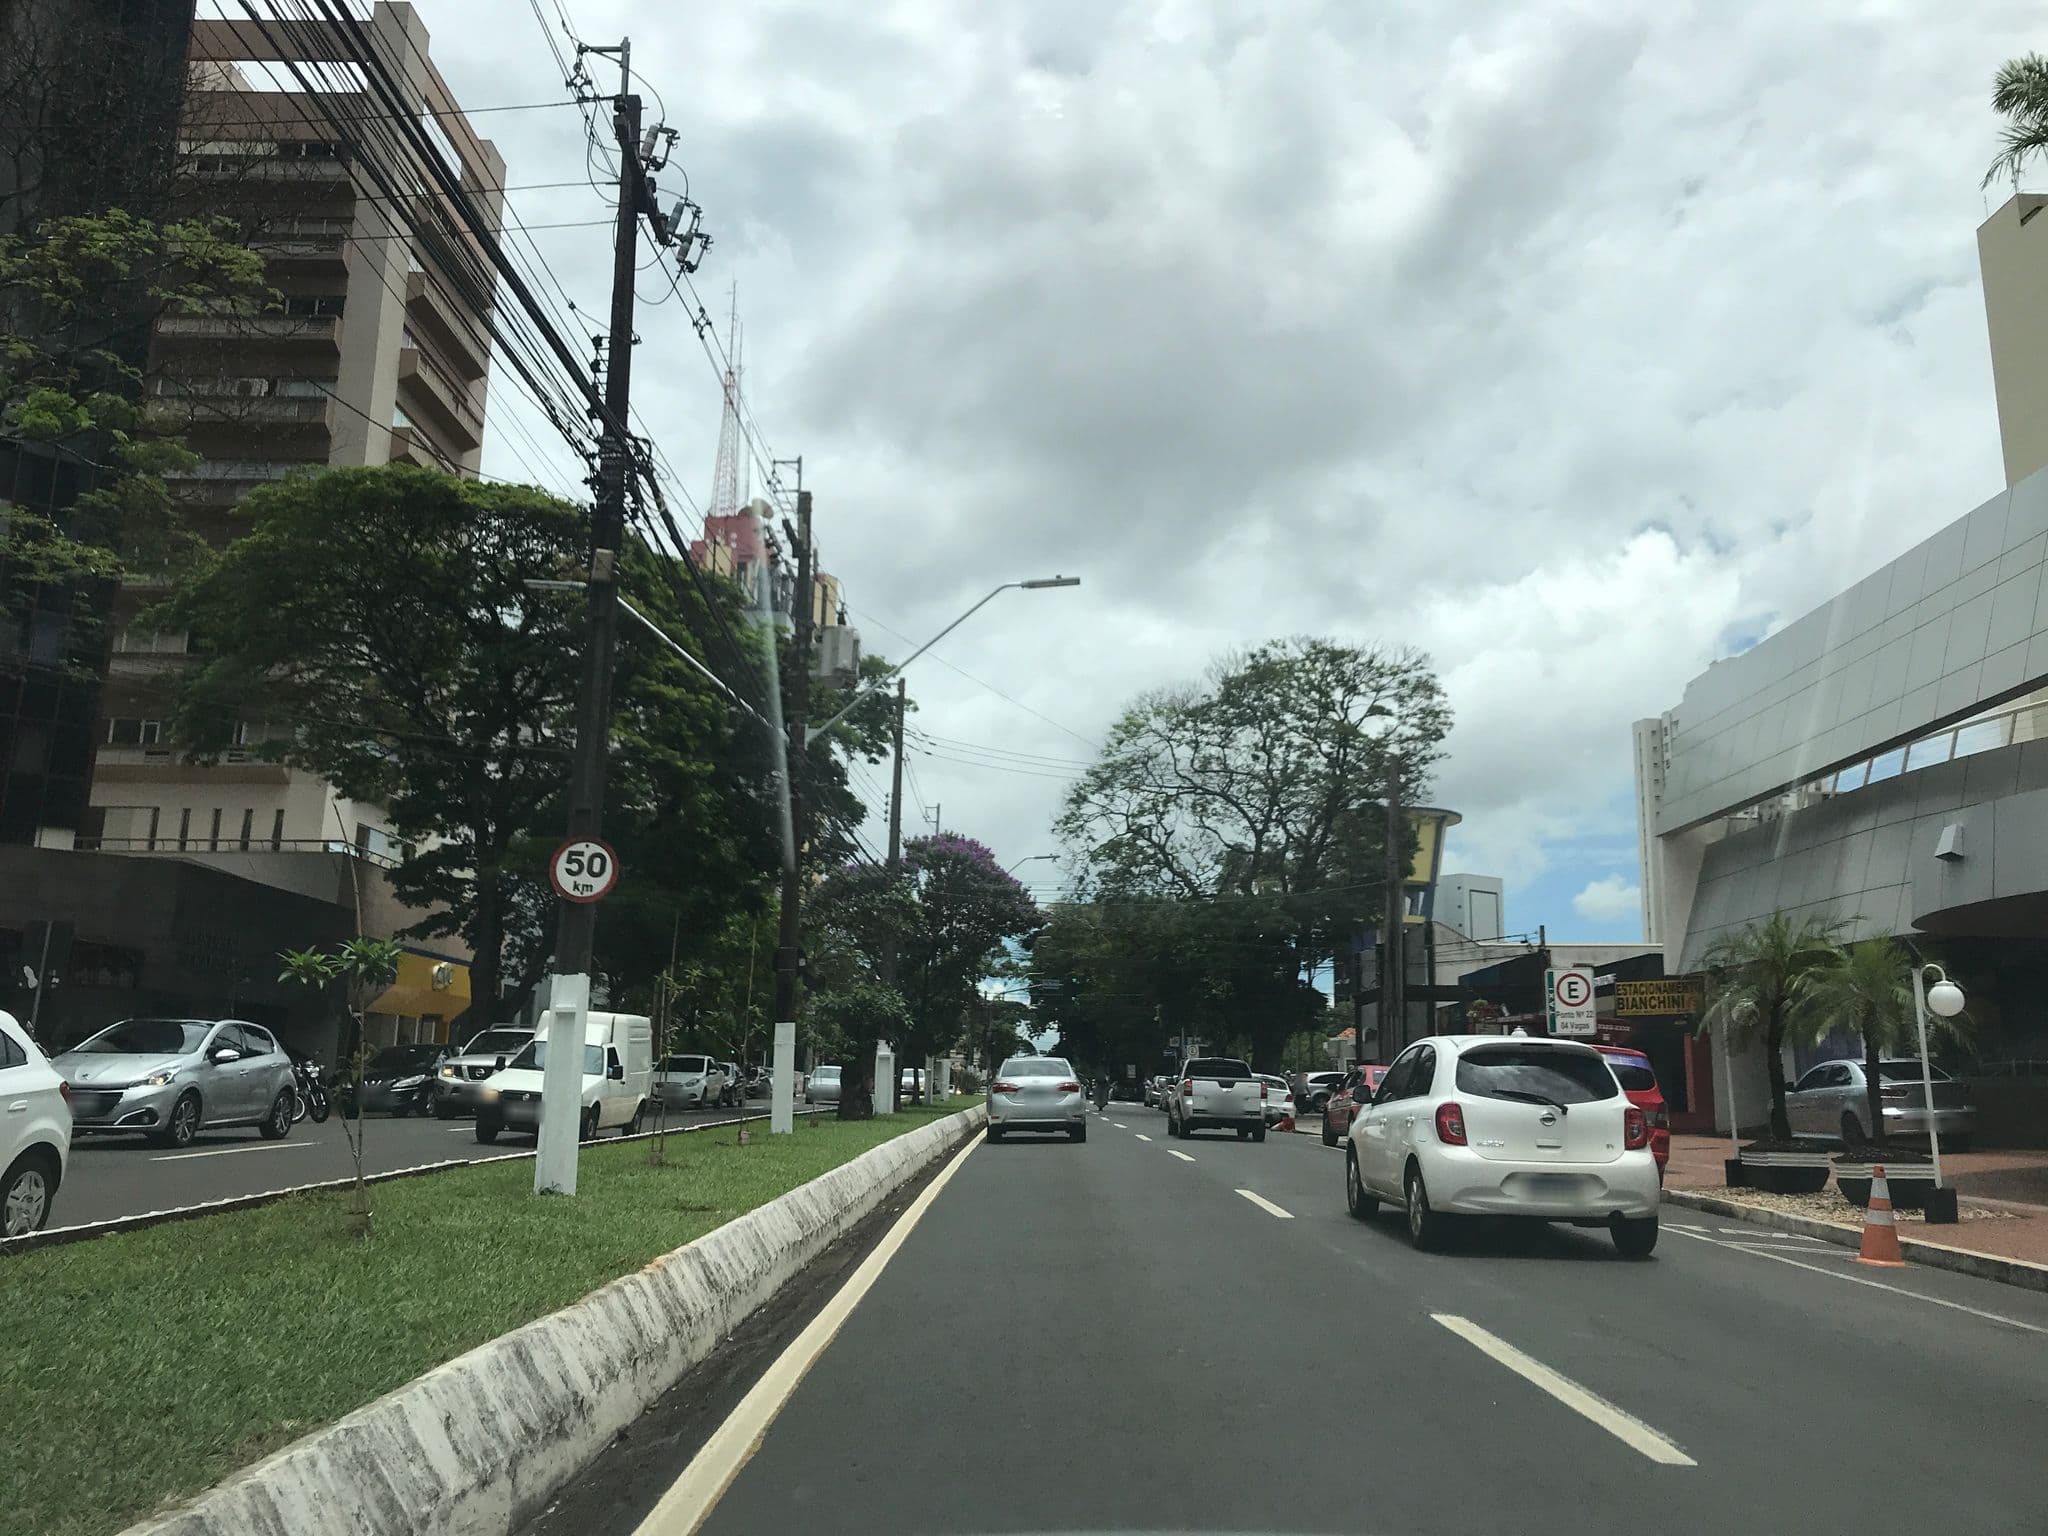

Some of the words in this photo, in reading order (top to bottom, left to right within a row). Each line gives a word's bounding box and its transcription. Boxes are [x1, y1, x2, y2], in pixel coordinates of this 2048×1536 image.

[564, 850, 608, 878] 50
[572, 880, 594, 893] km
[1567, 981, 1580, 999] E
[1617, 995, 1685, 1011] BIANCHINI
[1585, 1010, 1595, 1019] 22
